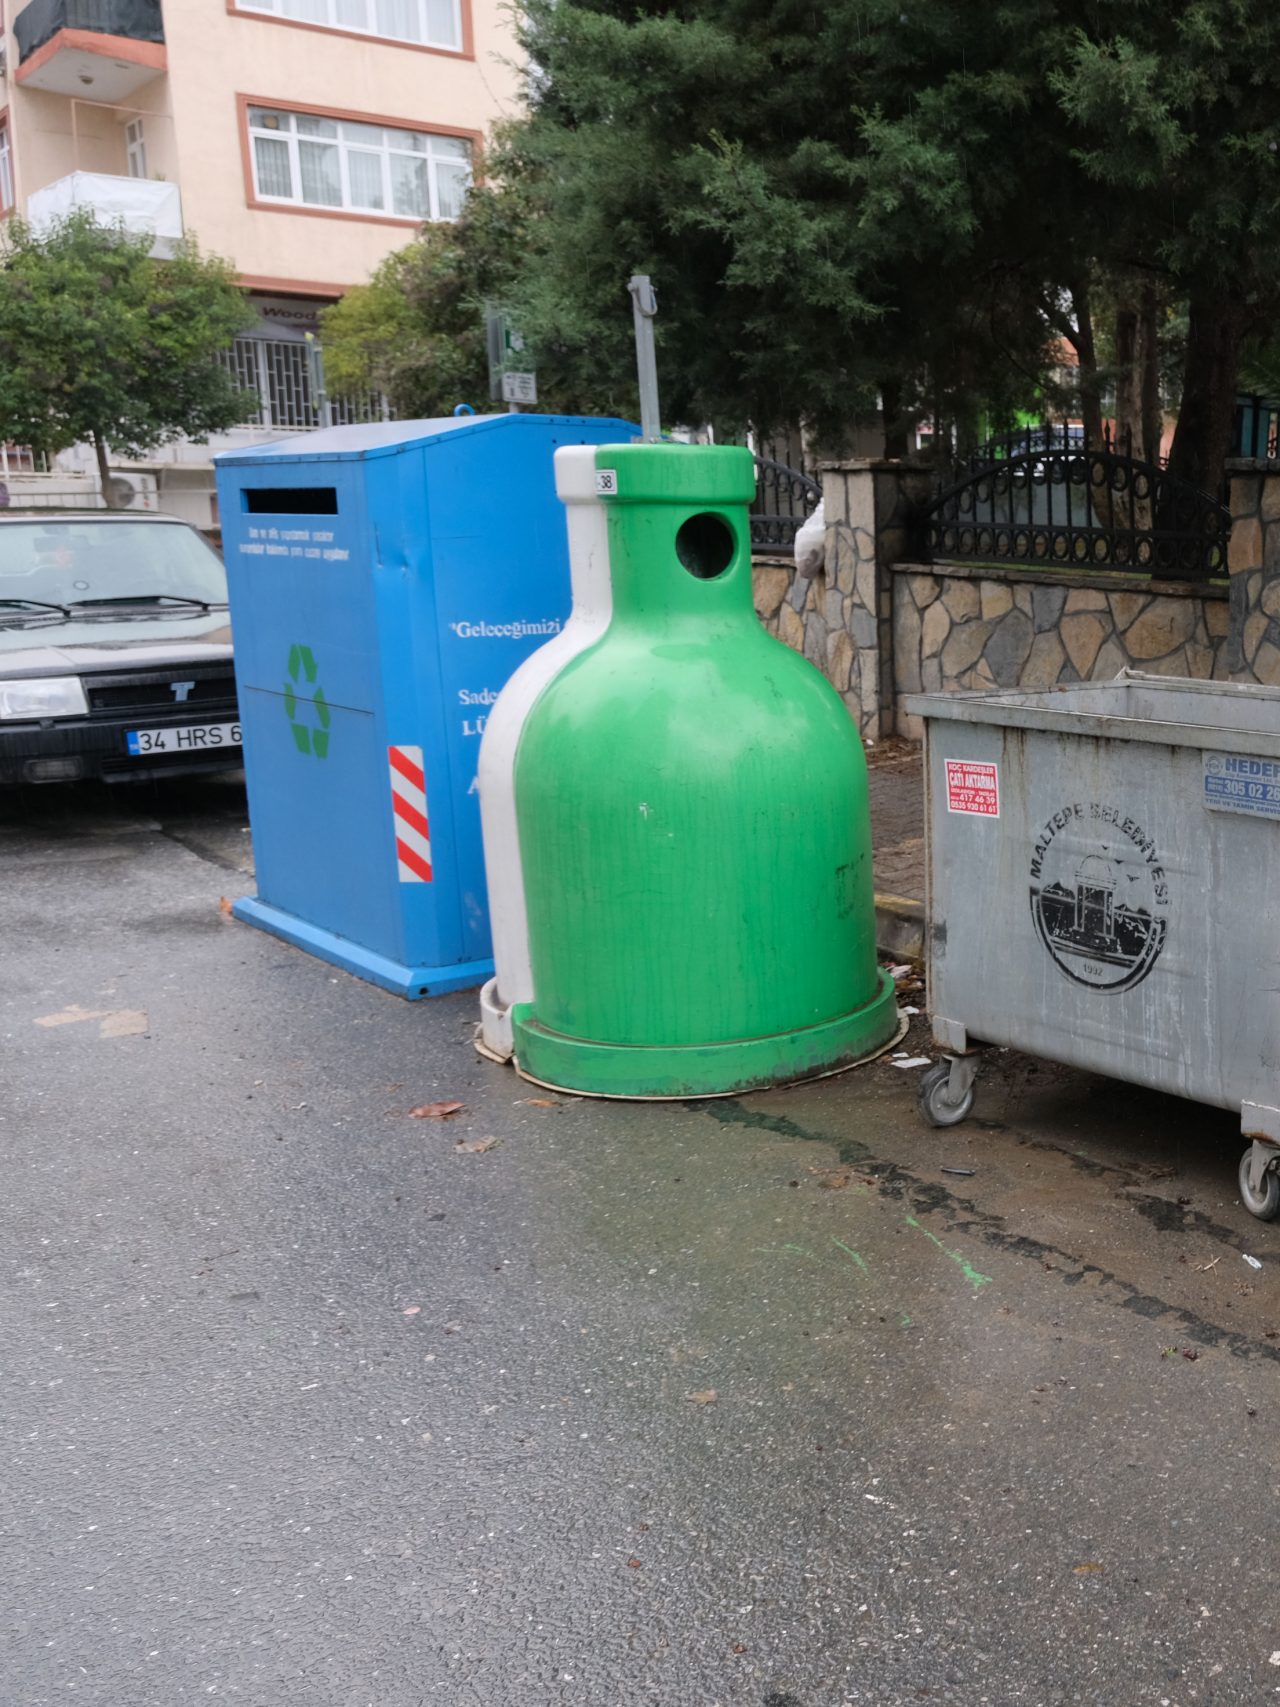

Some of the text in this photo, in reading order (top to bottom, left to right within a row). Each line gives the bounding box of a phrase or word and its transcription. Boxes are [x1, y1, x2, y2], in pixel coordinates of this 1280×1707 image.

[140, 732, 166, 751] 34
[177, 727, 223, 748] HRS
[950, 772, 996, 790] ÇATI AKTARMA
[1224, 780, 1246, 796] 305
[1248, 783, 1263, 798] 02
[1266, 786, 1280, 801] 26
[960, 794, 973, 802] 417
[975, 795, 984, 804] 46
[1030, 803, 1084, 880] MALTEPE
